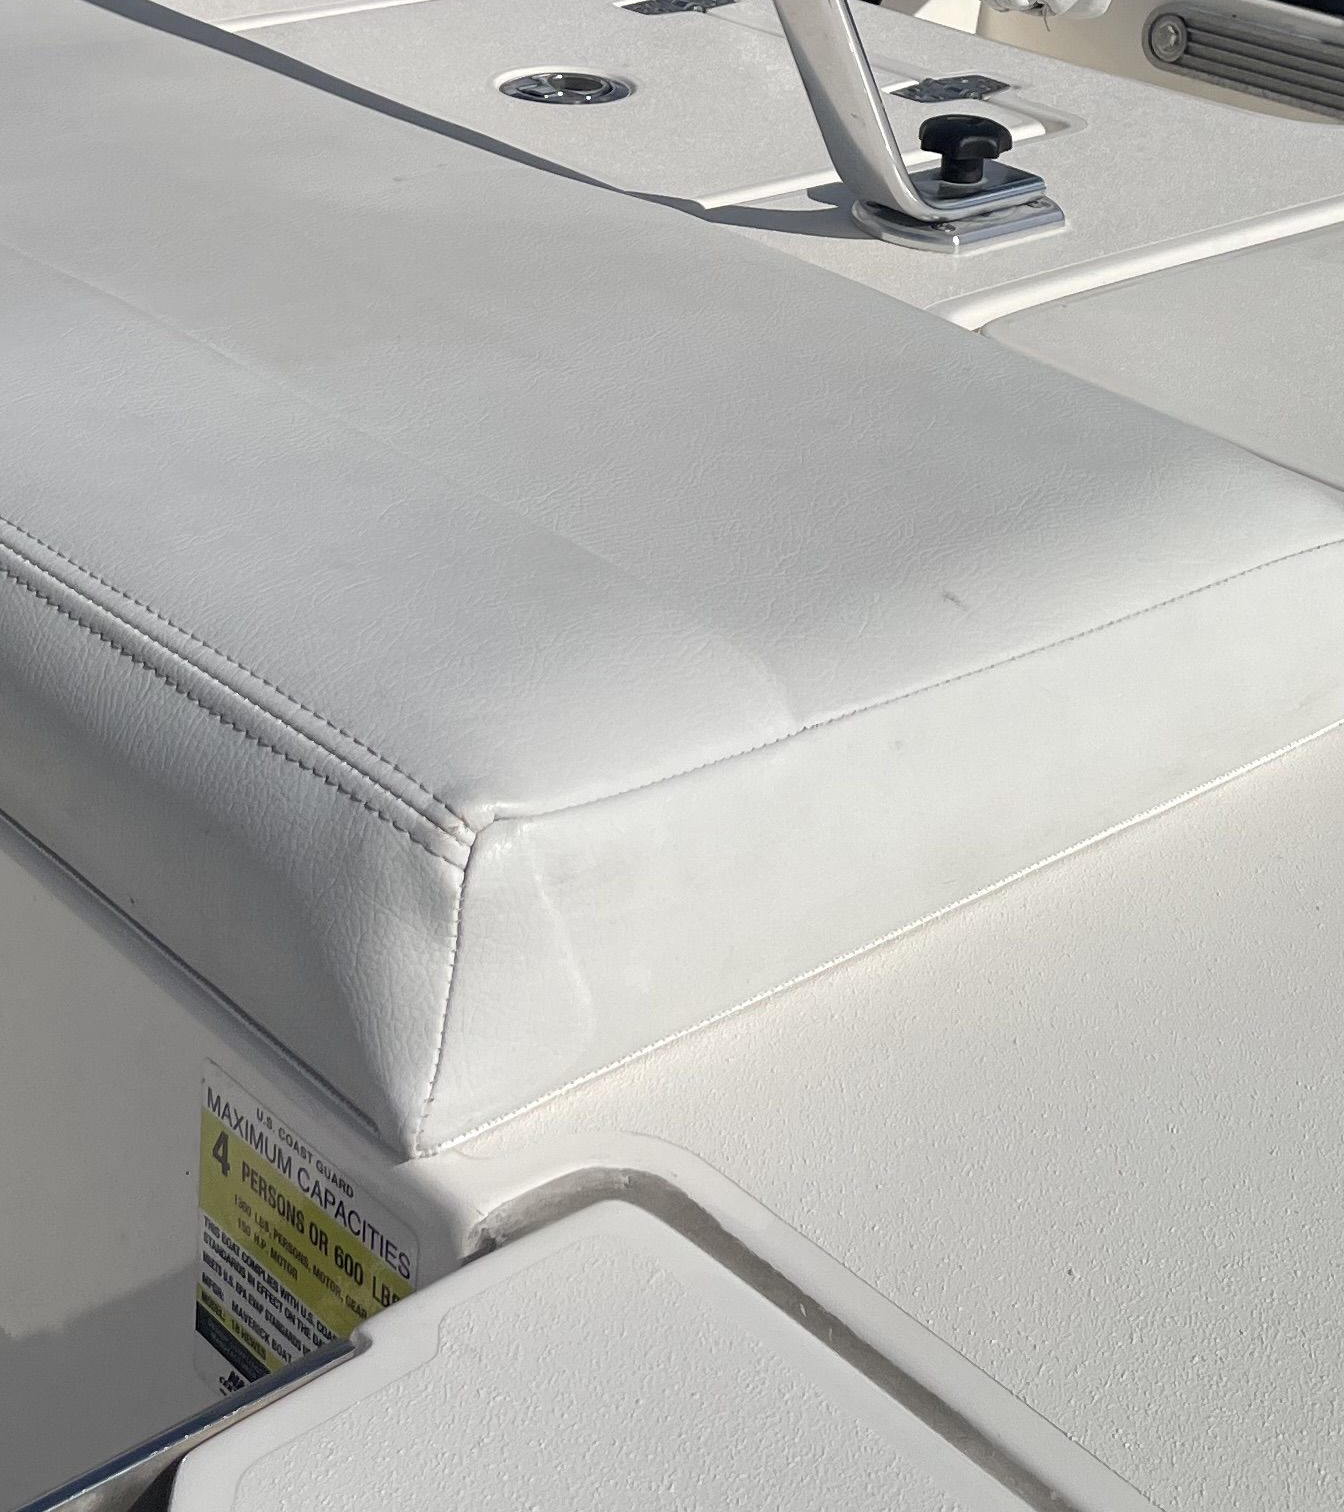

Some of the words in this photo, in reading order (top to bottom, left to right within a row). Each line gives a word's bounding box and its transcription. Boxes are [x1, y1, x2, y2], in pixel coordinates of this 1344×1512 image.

[207, 1085, 291, 1180] MAXIMUM
[297, 1162, 410, 1282] CAPACITIES
[256, 1107, 274, 1134] U.S.
[278, 1125, 312, 1165] COAST
[316, 1157, 353, 1201] GUARD
[212, 1131, 231, 1176] 4
[241, 1159, 304, 1236] PERSONS
[309, 1220, 327, 1257] OR
[334, 1243, 362, 1288] 600
[221, 1231, 239, 1257] BOAT
[279, 1283, 298, 1312] WITH
[270, 1245, 297, 1280] MOTOR
[231, 1298, 269, 1345] MAVERICK
[271, 1336, 291, 1366] BOAT
[247, 1271, 255, 1288] IN
[256, 1279, 282, 1314] EFFECT
[284, 1305, 295, 1325] ON
[297, 1317, 310, 1340] THE
